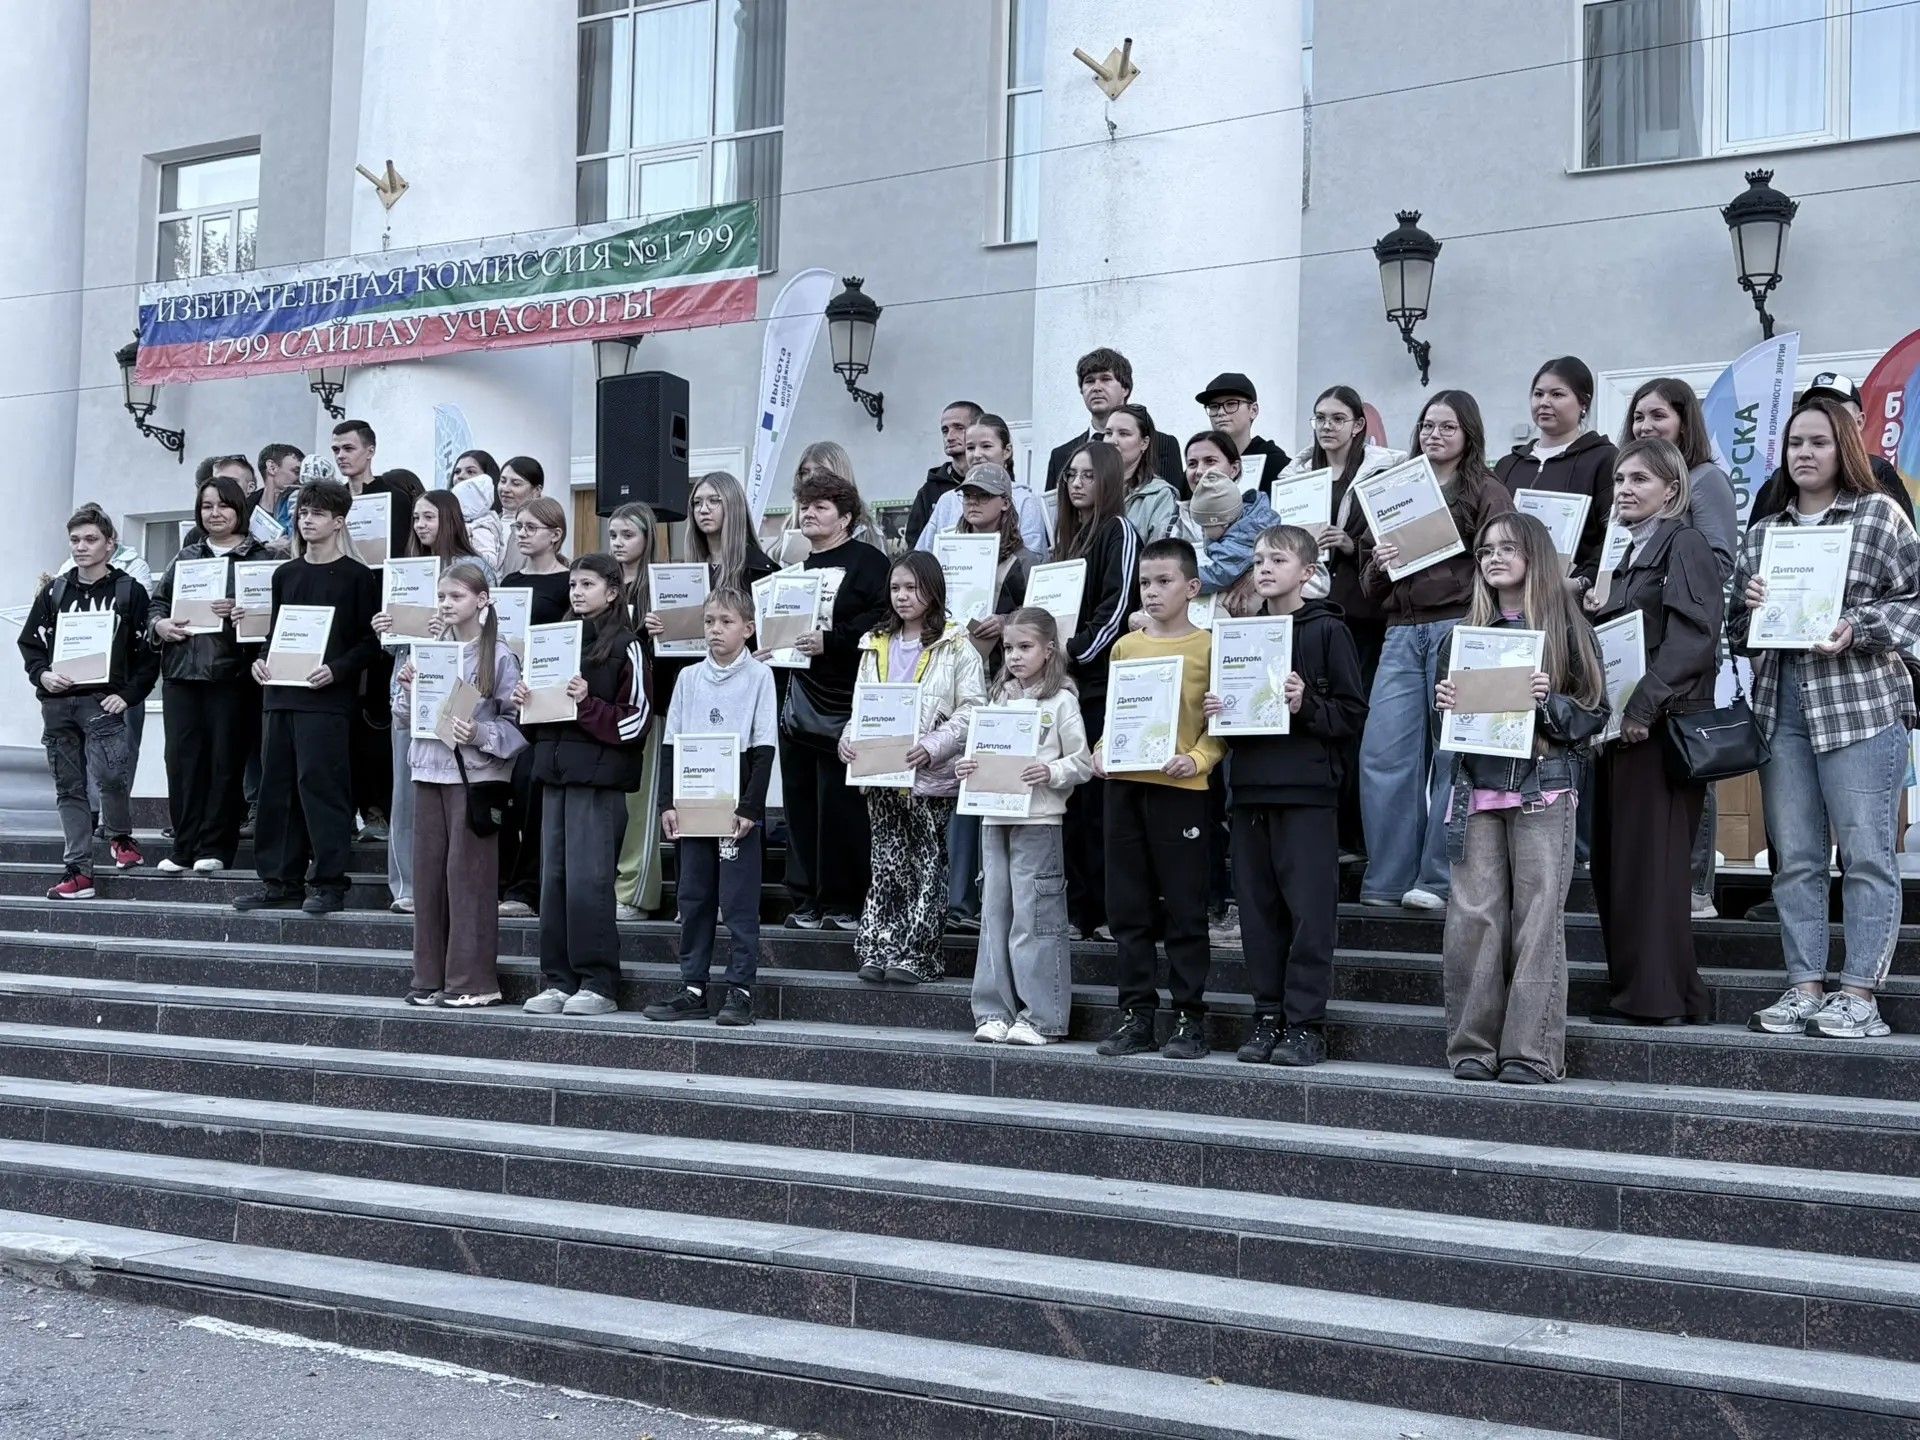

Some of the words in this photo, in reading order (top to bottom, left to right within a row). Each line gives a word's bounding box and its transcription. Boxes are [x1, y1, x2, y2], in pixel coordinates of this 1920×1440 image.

[155, 267, 405, 323] ИЗБИРАТЕЛЬНАЯ
[415, 240, 612, 293] КОМИССИЯ
[623, 222, 735, 267] №1799
[205, 332, 270, 366] 1799
[279, 314, 428, 359] САЙЛАУ
[438, 287, 656, 342] УЧАСТОГЫ
[1768, 376, 1782, 436] ВОЗМОЖНОСТИ
[1775, 343, 1787, 374] ЭНЕРГИЯ
[1279, 503, 1309, 514] Диплом
[1376, 497, 1414, 518] Диплом
[941, 563, 973, 571] Диплом
[1771, 565, 1815, 574] Диплом
[1032, 592, 1062, 602] Диплом
[531, 656, 560, 665] Диплом
[1222, 655, 1262, 664] Диплом
[418, 672, 444, 680] Диплом
[1116, 696, 1153, 705] Диплом
[861, 714, 896, 723] Диплом
[976, 741, 1012, 750] Диплом
[682, 766, 716, 774] Диплом
